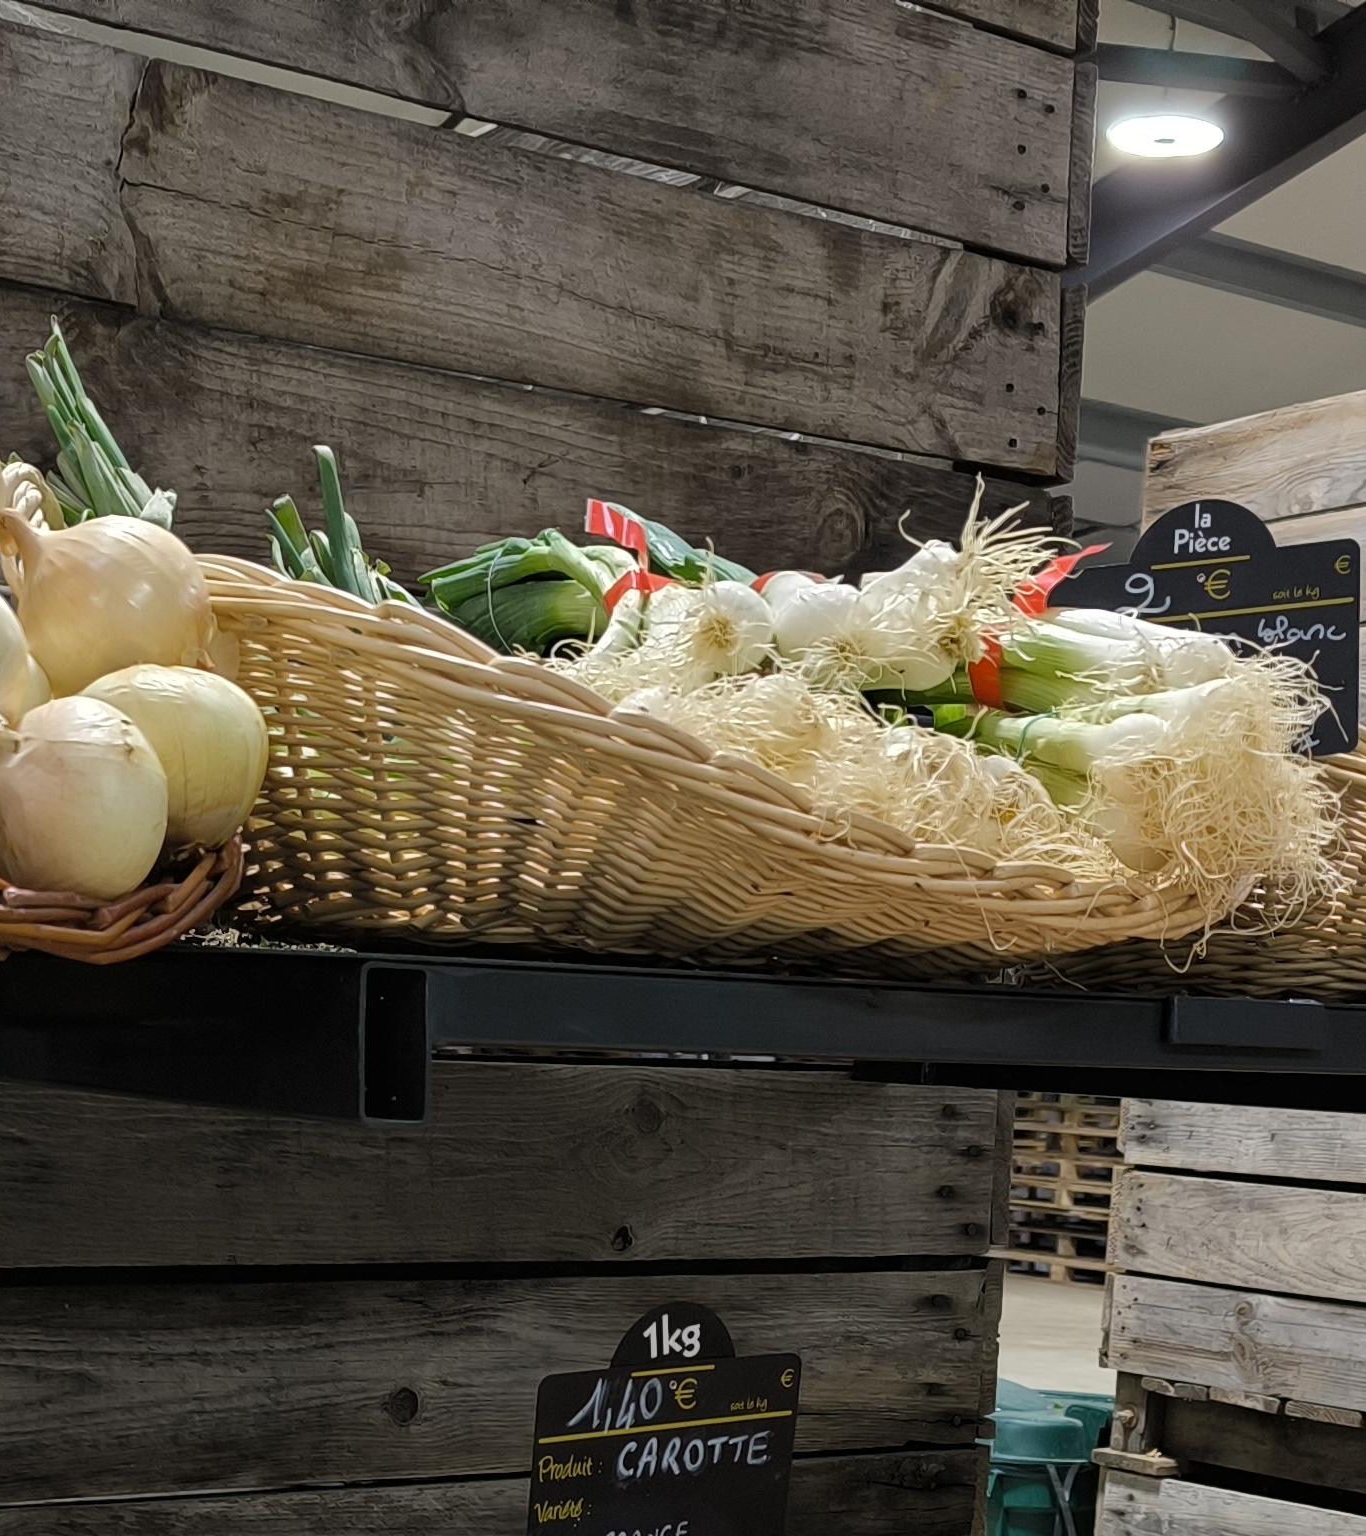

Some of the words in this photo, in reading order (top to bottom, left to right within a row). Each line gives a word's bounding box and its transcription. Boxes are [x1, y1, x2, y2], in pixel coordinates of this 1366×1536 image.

[1194, 503, 1212, 529] la
[1173, 529, 1231, 555] Pièce
[1335, 555, 1351, 575] €
[1204, 569, 1231, 600] €
[1257, 616, 1347, 642] blanc
[643, 1314, 701, 1359] 1kg
[780, 1368, 795, 1387] €
[567, 1377, 662, 1434] 1,40
[673, 1378, 698, 1410] €
[538, 1455, 593, 1483] Produit
[616, 1430, 773, 1480] CAROTTE
[534, 1498, 584, 1524] Variété
